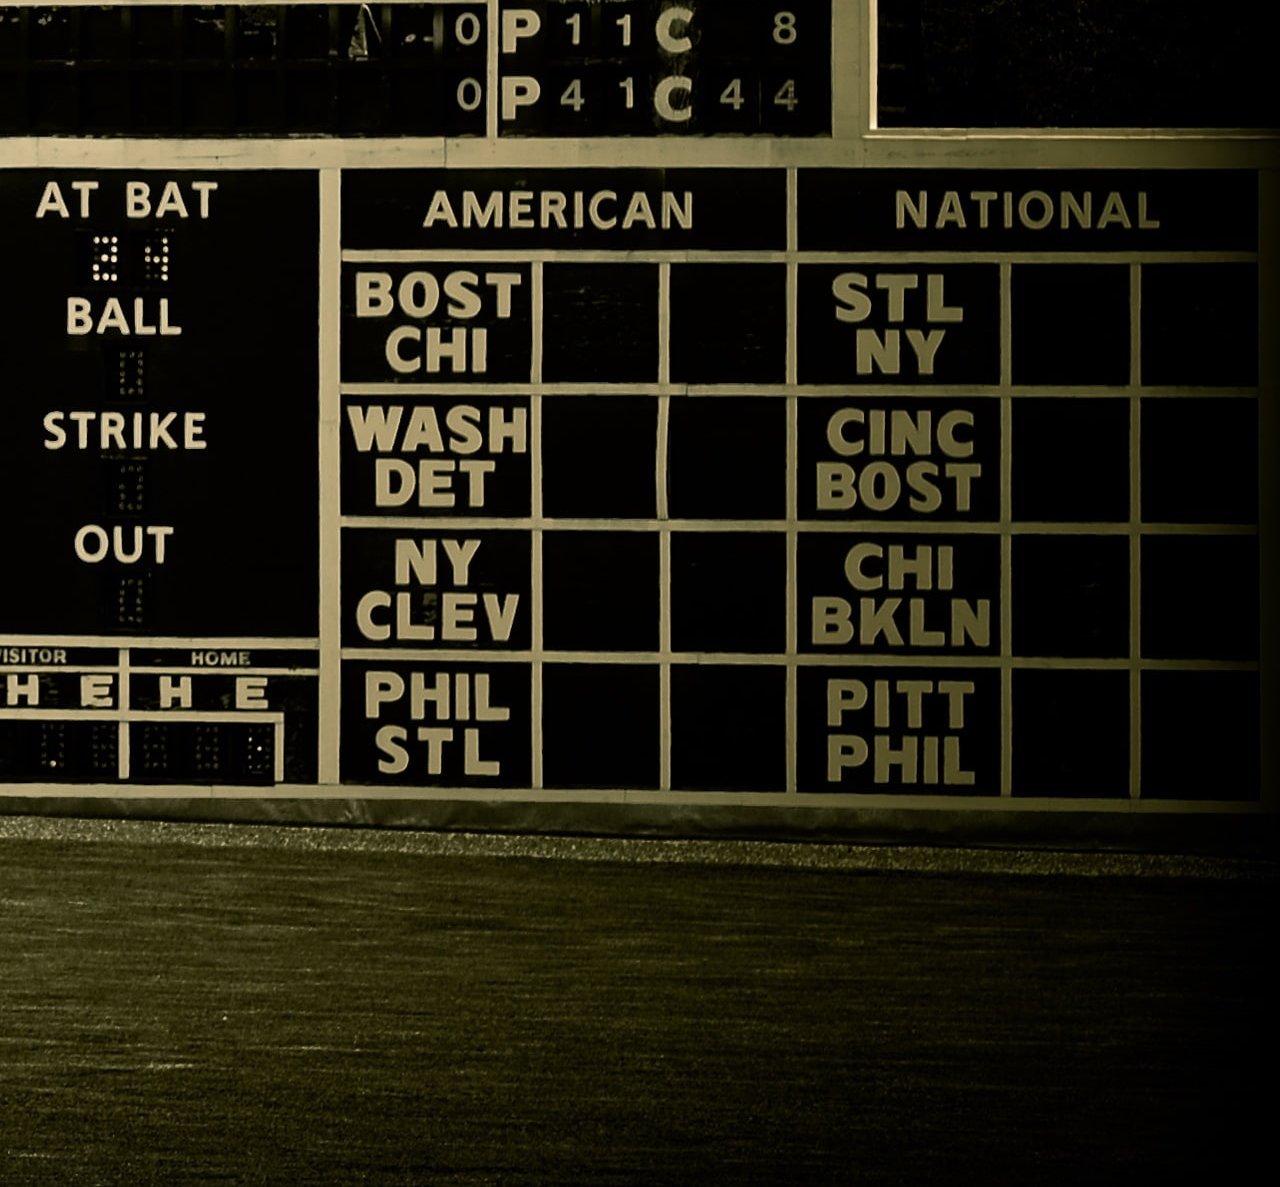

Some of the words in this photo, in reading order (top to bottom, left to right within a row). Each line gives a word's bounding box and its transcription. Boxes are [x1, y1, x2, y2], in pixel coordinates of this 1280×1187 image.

[455, 12, 481, 46] 0
[501, 9, 541, 54] P
[772, 11, 797, 45] 8
[456, 77, 482, 111] 0
[501, 75, 541, 120] P
[35, 181, 99, 218] AT
[126, 181, 219, 219] BAT
[422, 189, 693, 230] AMERICAN
[895, 189, 1160, 230] NATIONAL
[66, 296, 182, 336] BALL
[355, 270, 522, 319] BOST
[831, 272, 964, 323] STL
[385, 325, 488, 373] CHI
[855, 328, 946, 375] NY
[43, 410, 207, 450] STRIKE
[346, 404, 527, 455] WASH
[826, 407, 975, 458] CINC
[375, 458, 496, 508] DET
[816, 460, 982, 513] BOST
[74, 524, 174, 564] OUT
[395, 538, 482, 586] NY
[844, 542, 954, 591] CHI
[356, 590, 520, 642] CLEV
[811, 596, 991, 647] BKLN
[190, 650, 252, 667] HOME
[6, 674, 40, 706] H
[80, 674, 114, 708] E
[159, 675, 193, 709] H
[235, 676, 269, 710] E
[365, 670, 511, 722] PHIL
[826, 678, 975, 729] PITT
[375, 724, 501, 776] STL
[827, 734, 976, 785] PHIL
